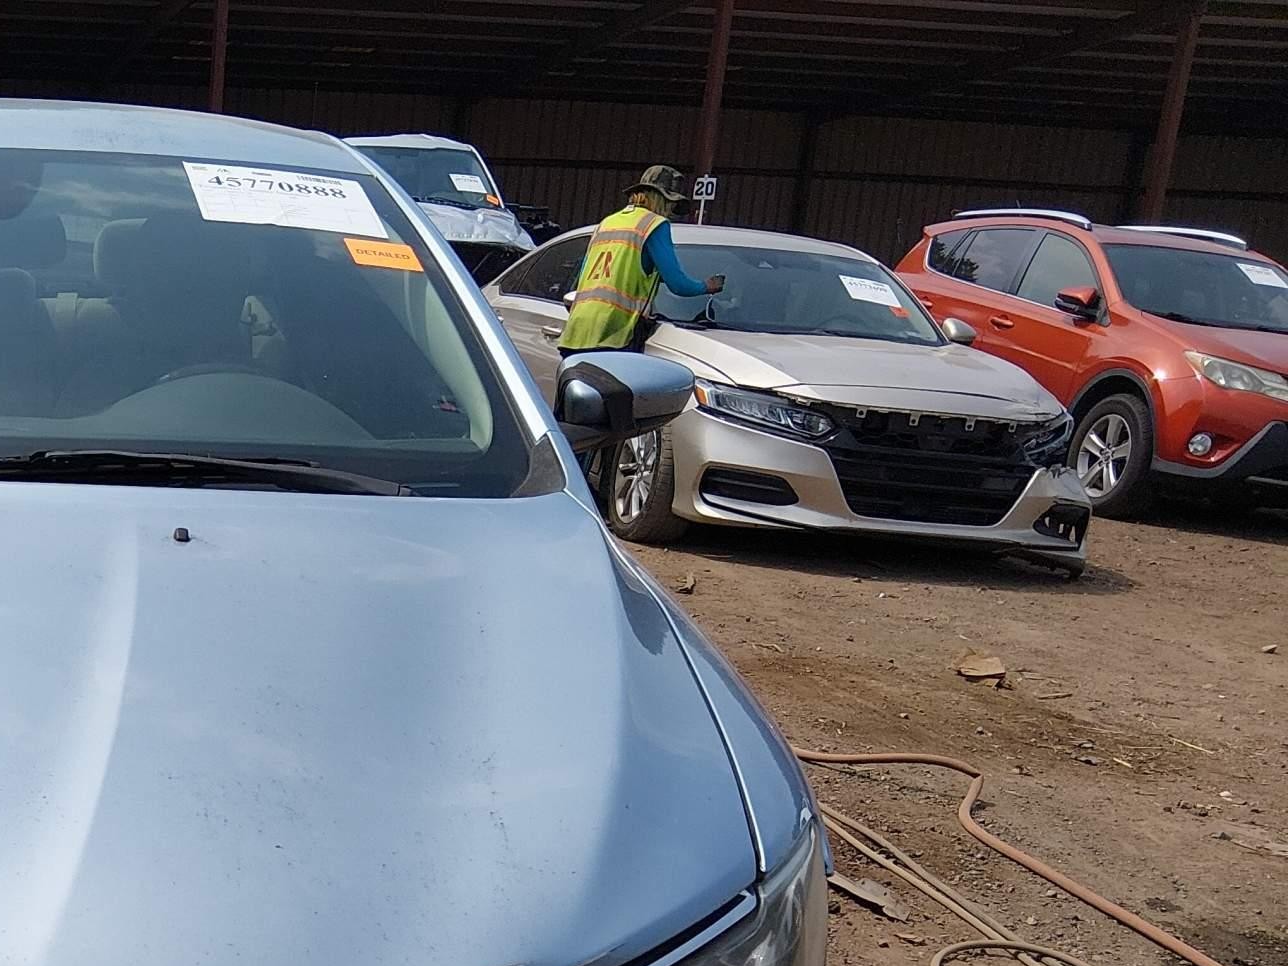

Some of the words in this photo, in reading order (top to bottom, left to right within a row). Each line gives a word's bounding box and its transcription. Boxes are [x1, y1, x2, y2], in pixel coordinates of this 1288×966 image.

[208, 176, 347, 199] 45770888
[695, 181, 715, 196] 20
[355, 248, 411, 260] DETAILED
